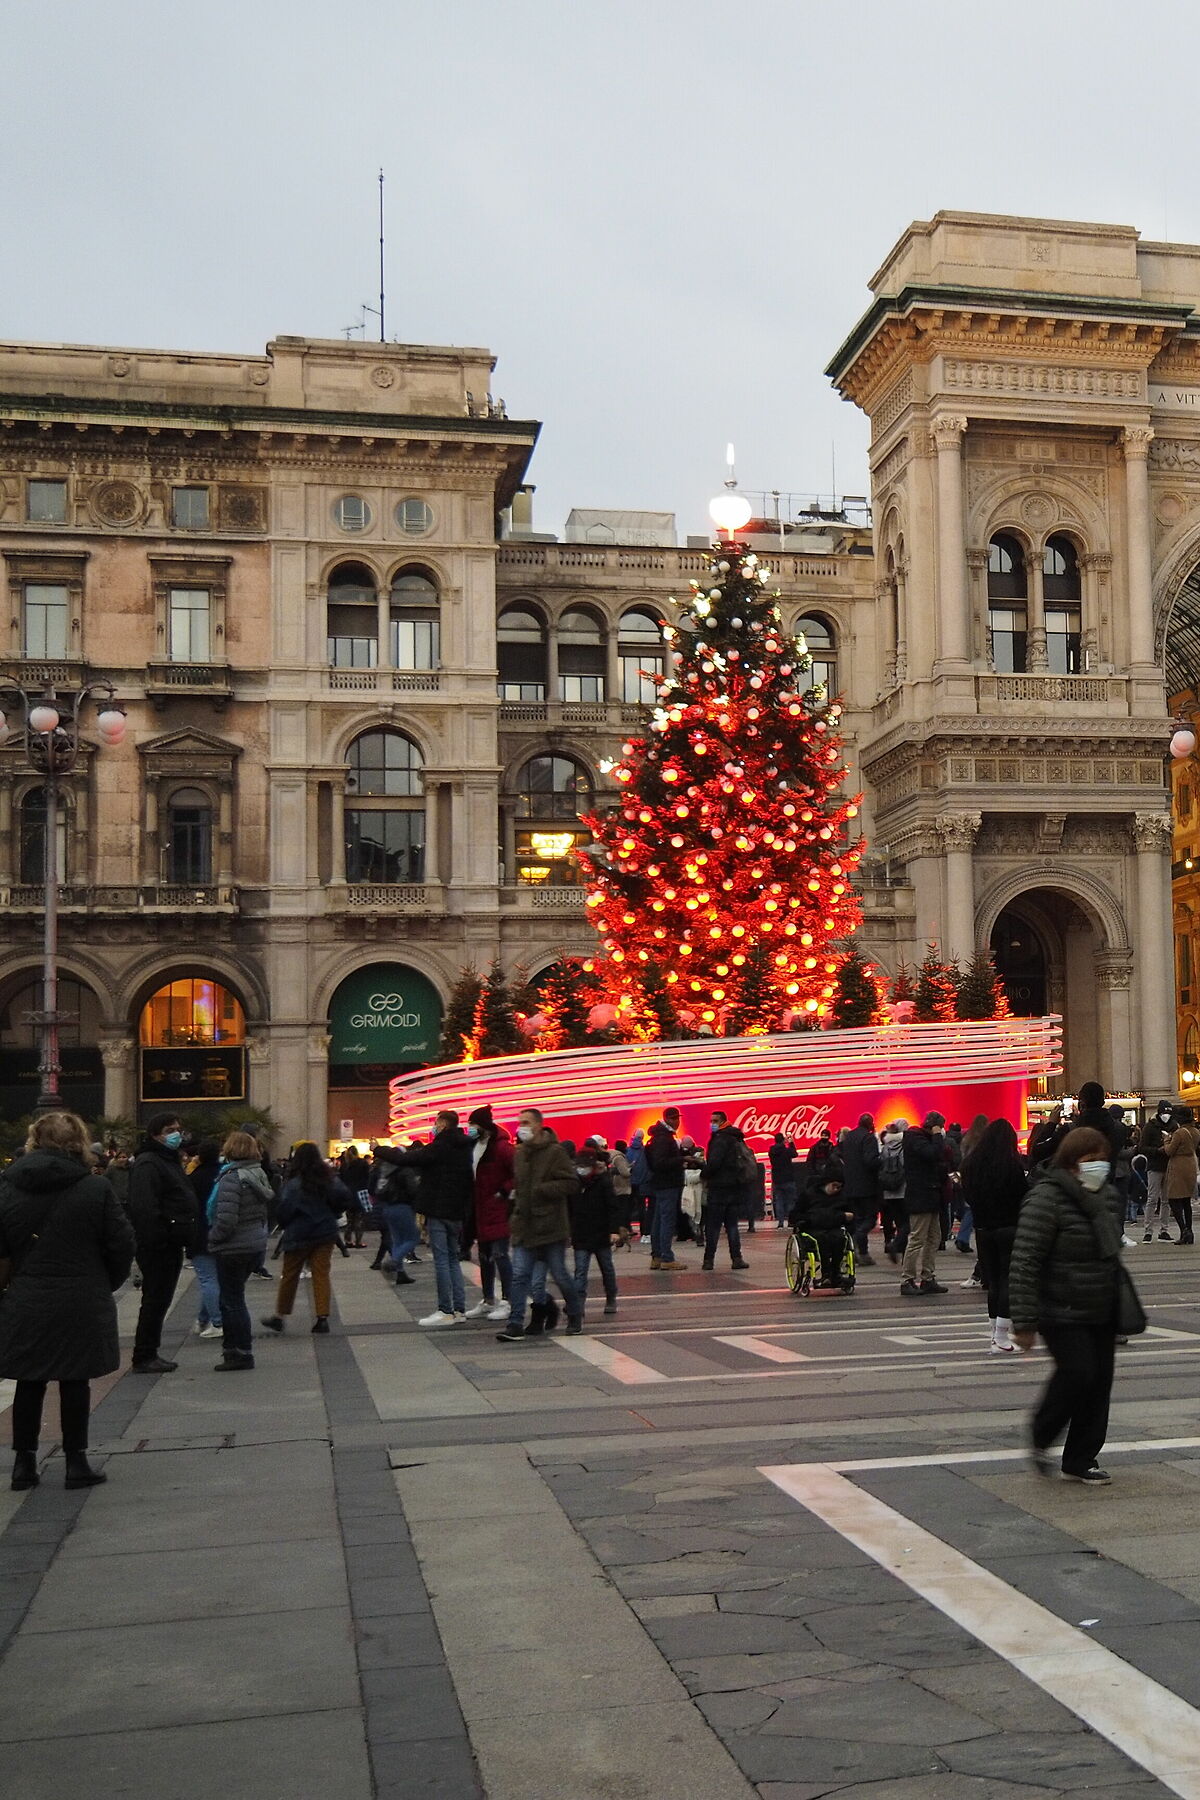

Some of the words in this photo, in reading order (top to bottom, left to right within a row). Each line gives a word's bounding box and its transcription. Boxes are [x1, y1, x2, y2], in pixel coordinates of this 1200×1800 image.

[1158, 392, 1166, 403] A
[350, 1013, 420, 1028] GRIMOLDI
[732, 1104, 836, 1140] Coca-Cola
